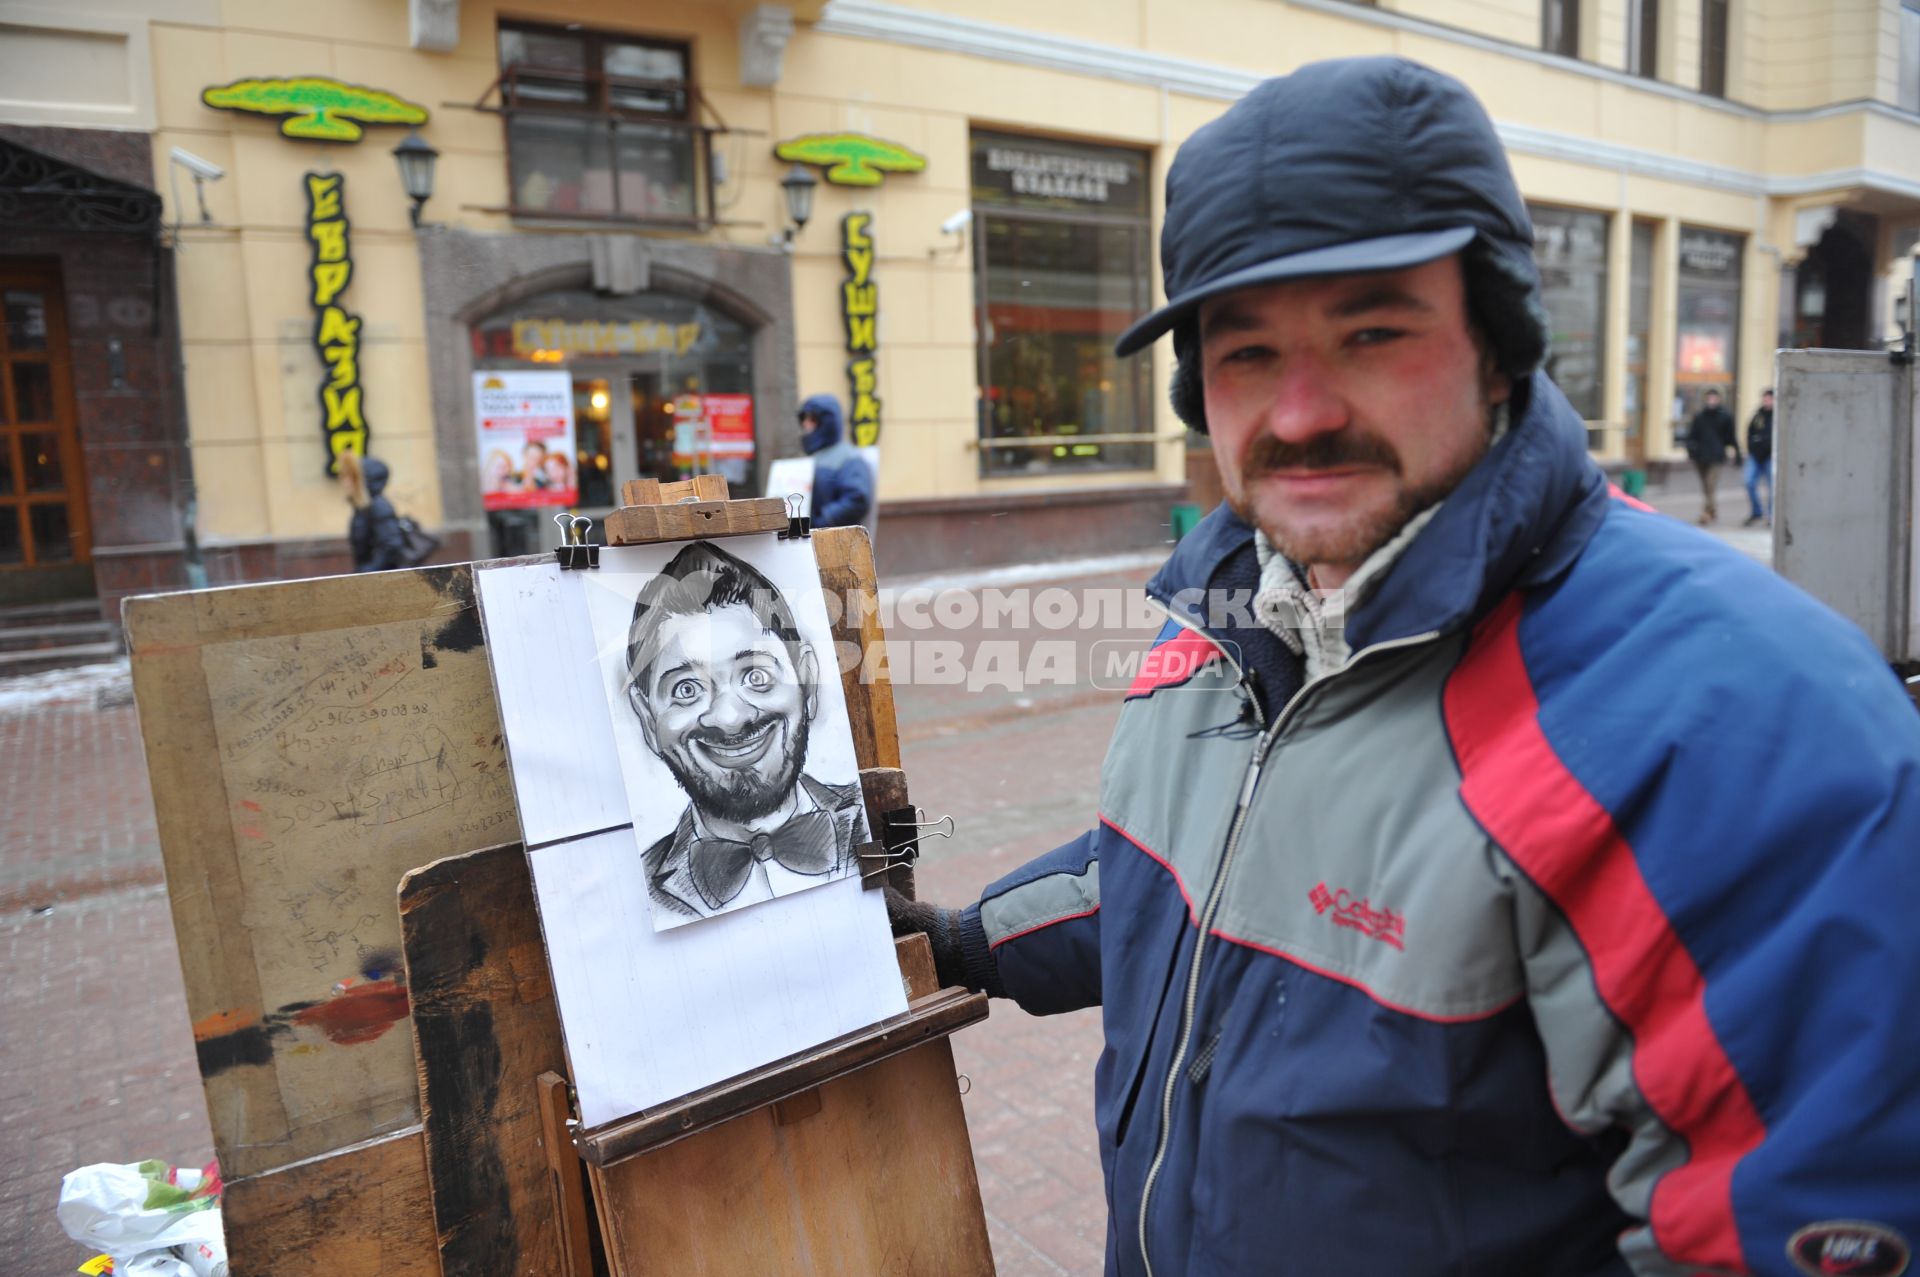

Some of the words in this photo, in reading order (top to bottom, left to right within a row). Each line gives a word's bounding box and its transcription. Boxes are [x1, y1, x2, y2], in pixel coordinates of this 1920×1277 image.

[306, 174, 367, 475] ЕВРАЗИЯ
[845, 214, 878, 351] СУШИ
[850, 358, 881, 447] БАР
[1821, 1234, 1879, 1262] NIKE
